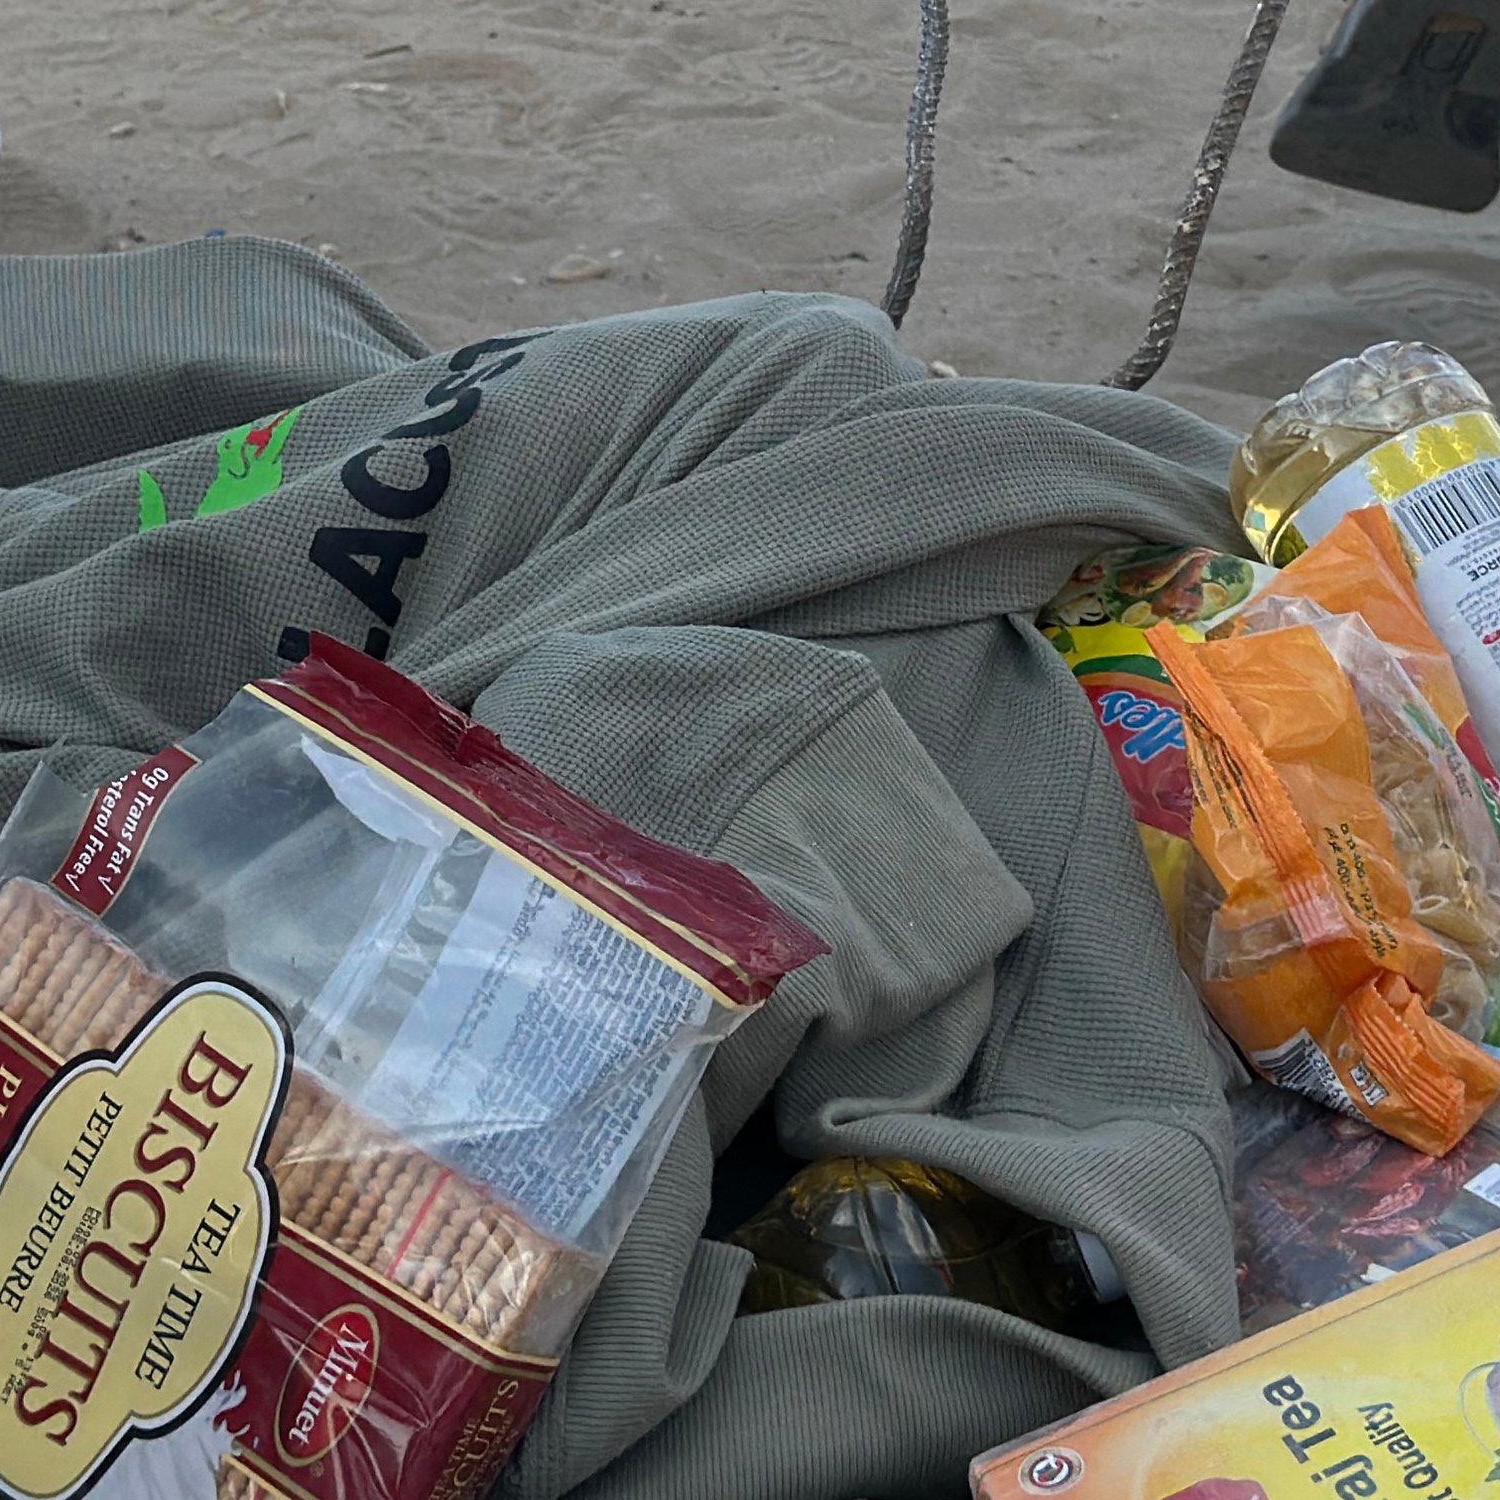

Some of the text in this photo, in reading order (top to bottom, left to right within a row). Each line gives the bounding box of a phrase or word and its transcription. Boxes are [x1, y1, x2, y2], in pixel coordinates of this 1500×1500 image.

[71, 833, 102, 875] Free
[104, 762, 170, 874] 0g Trans Fat
[57, 1089, 125, 1188] PETIT
[7, 1030, 253, 1447] BISCUITS
[125, 1193, 243, 1391] TEA TIME
[282, 1320, 374, 1454] Minuet
[1262, 1374, 1336, 1463] Tea
[1358, 1403, 1438, 1488] Quality
